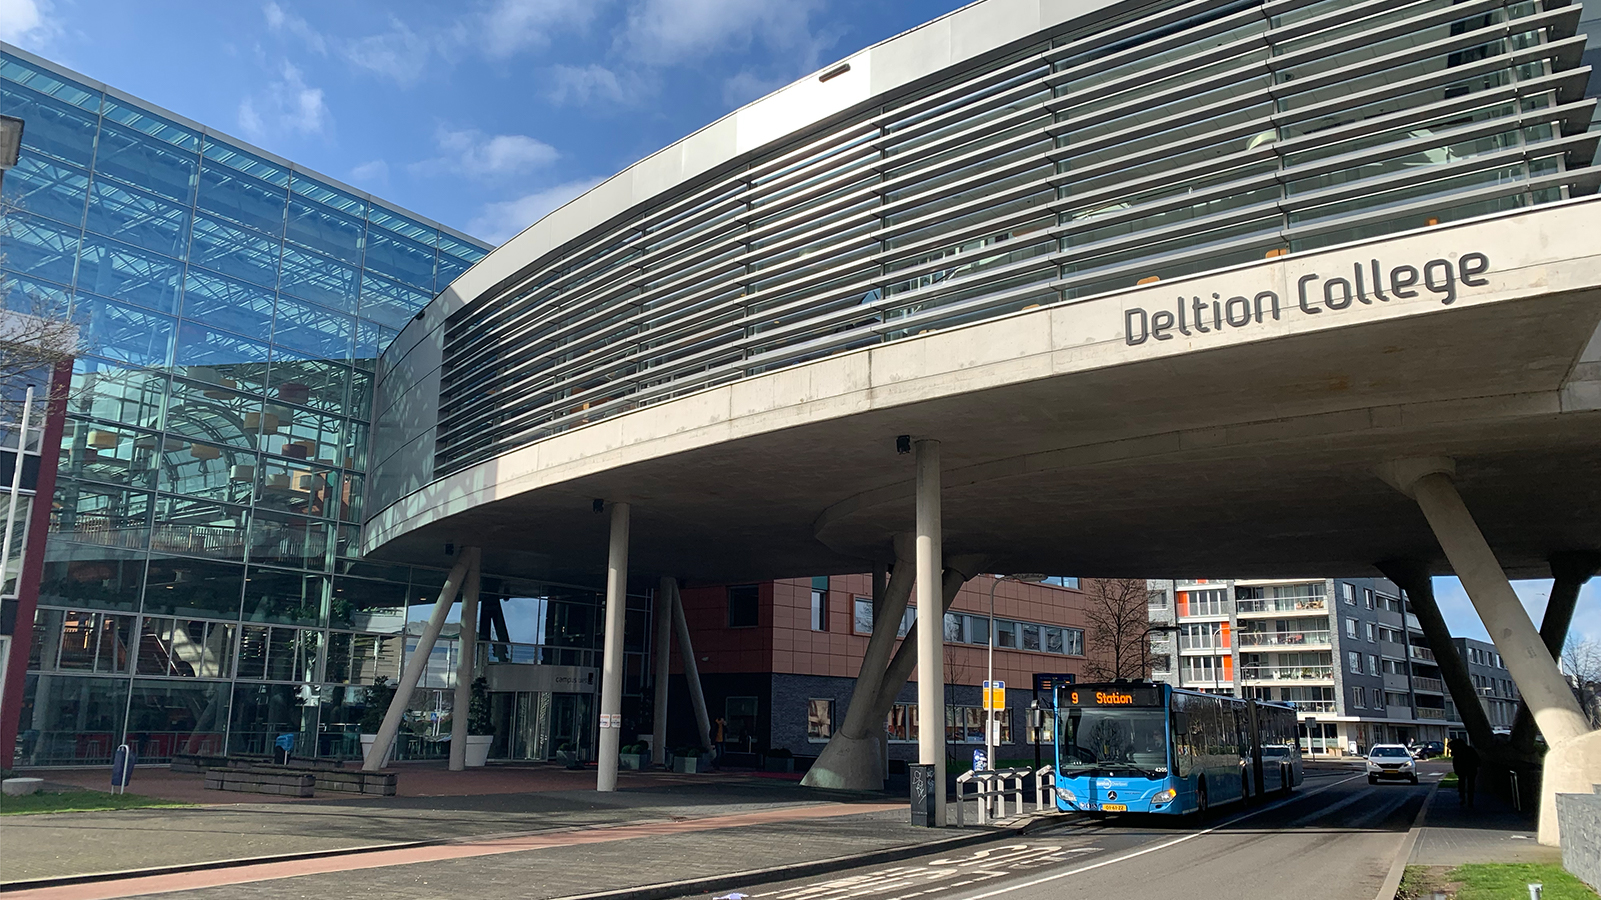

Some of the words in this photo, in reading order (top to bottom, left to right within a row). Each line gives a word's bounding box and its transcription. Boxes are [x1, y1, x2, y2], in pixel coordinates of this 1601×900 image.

[1125, 290, 1280, 346] Deltion
[1298, 251, 1490, 314] College
[1071, 692, 1079, 704] 9
[1096, 692, 1132, 704] Station
